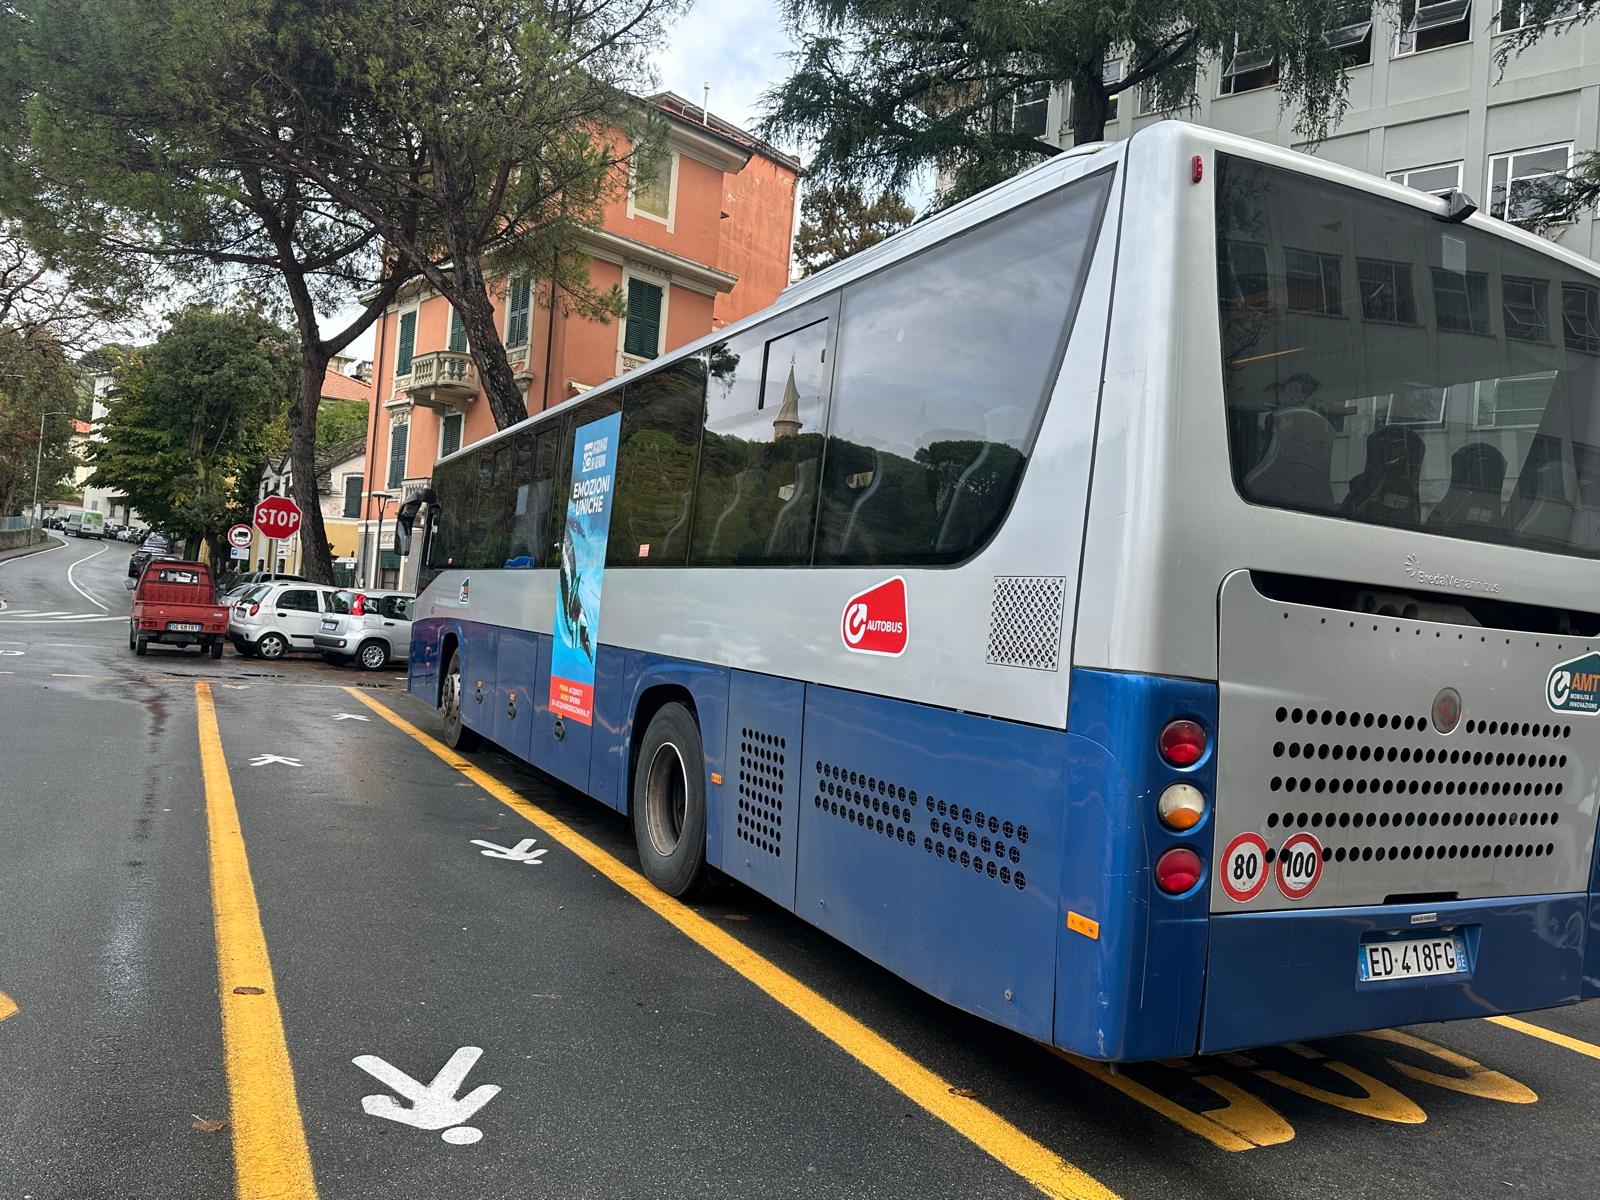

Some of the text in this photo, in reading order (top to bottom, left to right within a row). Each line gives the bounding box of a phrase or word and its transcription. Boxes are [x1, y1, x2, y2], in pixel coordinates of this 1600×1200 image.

[573, 475, 611, 499] EMOZIONI
[575, 496, 604, 516] UNICHE
[257, 508, 299, 528] STOP
[866, 619, 903, 634] AUTOBUS
[1571, 672, 1600, 692] AMT
[1233, 853, 1258, 880] 80
[1286, 851, 1316, 878] 100
